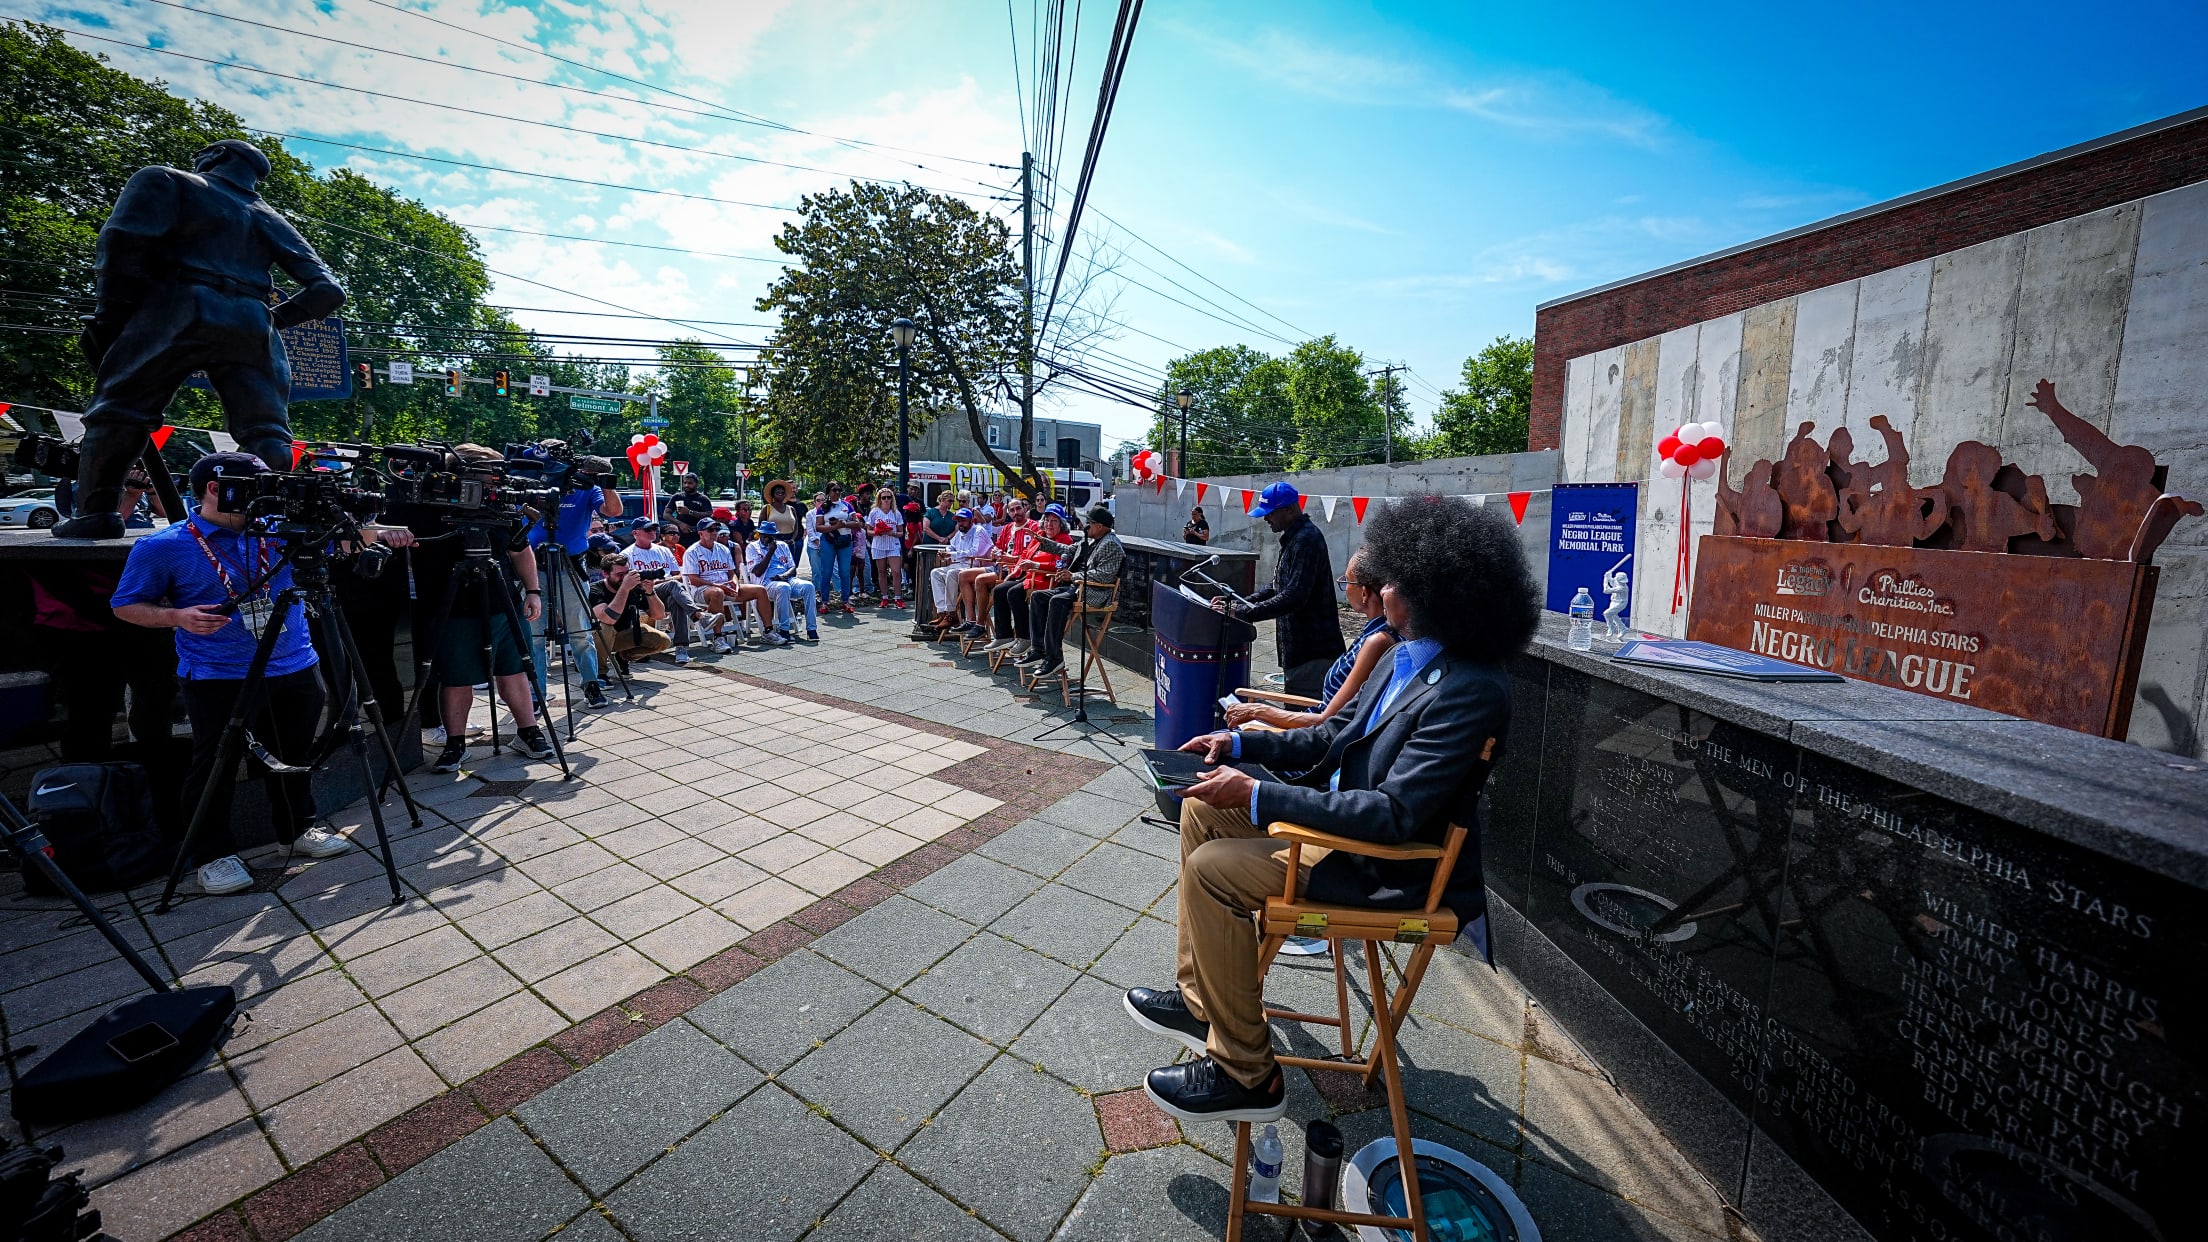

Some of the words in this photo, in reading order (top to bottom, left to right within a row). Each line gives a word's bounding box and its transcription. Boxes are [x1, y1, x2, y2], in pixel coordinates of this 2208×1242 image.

[572, 402, 605, 411] Belmont
[212, 465, 225, 478] P
[955, 465, 1001, 494] CALL
[1023, 534, 1032, 548] P
[1559, 539, 1599, 551] MEMORIAL
[1602, 541, 1624, 553] PARK
[1562, 529, 1588, 540] NEGRO
[1591, 530, 1622, 542] LEAGUE
[1878, 574, 1935, 598] Phillies
[1754, 603, 1789, 622] MILLER
[1835, 616, 1927, 645] PHILADELPHIA
[1929, 630, 1980, 654] STARS
[1749, 620, 1836, 669] NEGRO
[1844, 636, 1976, 700] LEAGUE
[1682, 731, 1699, 751] TO
[1704, 740, 1733, 764] THE
[1738, 754, 1774, 781] MEN
[1782, 771, 1809, 795] OF
[1815, 783, 1851, 814] THE
[1859, 802, 2031, 891] PHILADELPHIA
[2046, 879, 2154, 941] STARS
[1922, 890, 2020, 956] WILMER
[2036, 946, 2161, 1023] HARRIS
[1926, 922, 2015, 976] JIMMY
[2028, 974, 2139, 1042] JONES
[1900, 972, 1984, 1034] HENRY
[1937, 946, 1997, 995] SLIM
[2010, 989, 2117, 1059] JONES
[1891, 944, 1969, 1000] LARRY
[1980, 995, 2185, 1128] KIMBROUGH
[1898, 1018, 2034, 1122] CLARENCE
[2050, 1117, 2140, 1192] PALM
[1905, 1000, 2001, 1074] HENNIE
[2016, 1067, 2130, 1158] MILLER
[1922, 1082, 1974, 1133] BILL
[1911, 1051, 1959, 1094] RED
[1972, 1091, 2101, 1185] PARNELL
